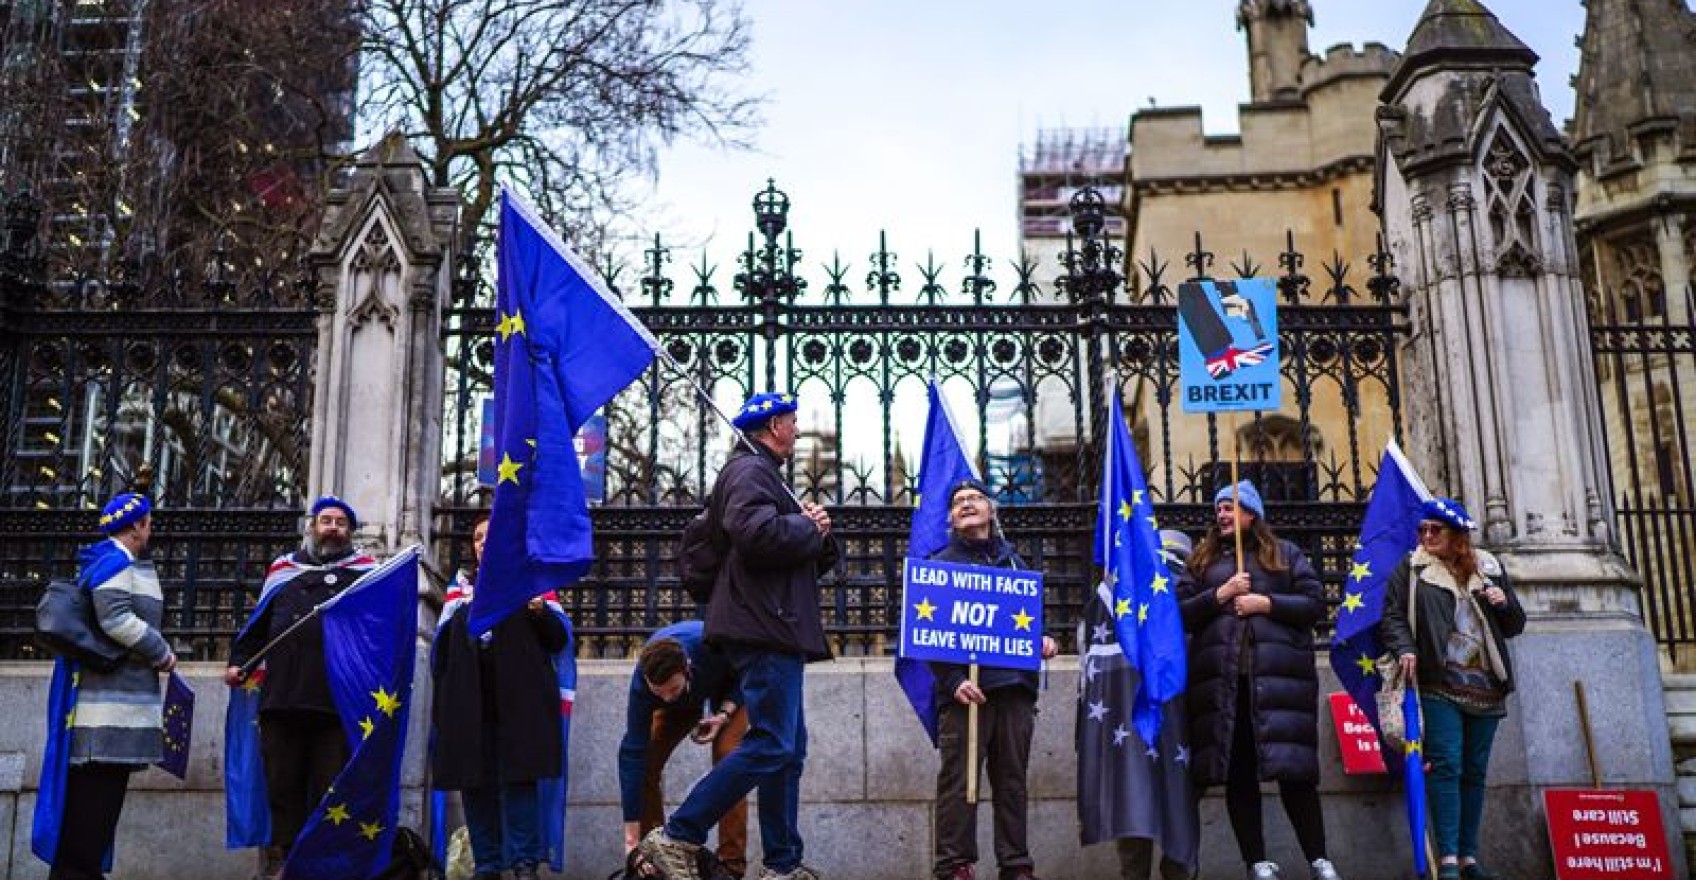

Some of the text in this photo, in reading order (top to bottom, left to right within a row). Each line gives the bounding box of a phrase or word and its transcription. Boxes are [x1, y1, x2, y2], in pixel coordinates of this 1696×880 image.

[1188, 383, 1273, 402] BREXIT
[911, 566, 1038, 597] LEAD WITH FACTS
[951, 601, 999, 628] NOT
[913, 628, 1033, 656] LEAVE WITH LIES
[1573, 810, 1640, 825] Still care
[1575, 833, 1646, 848] Because I
[1567, 856, 1662, 872] I'm still here
